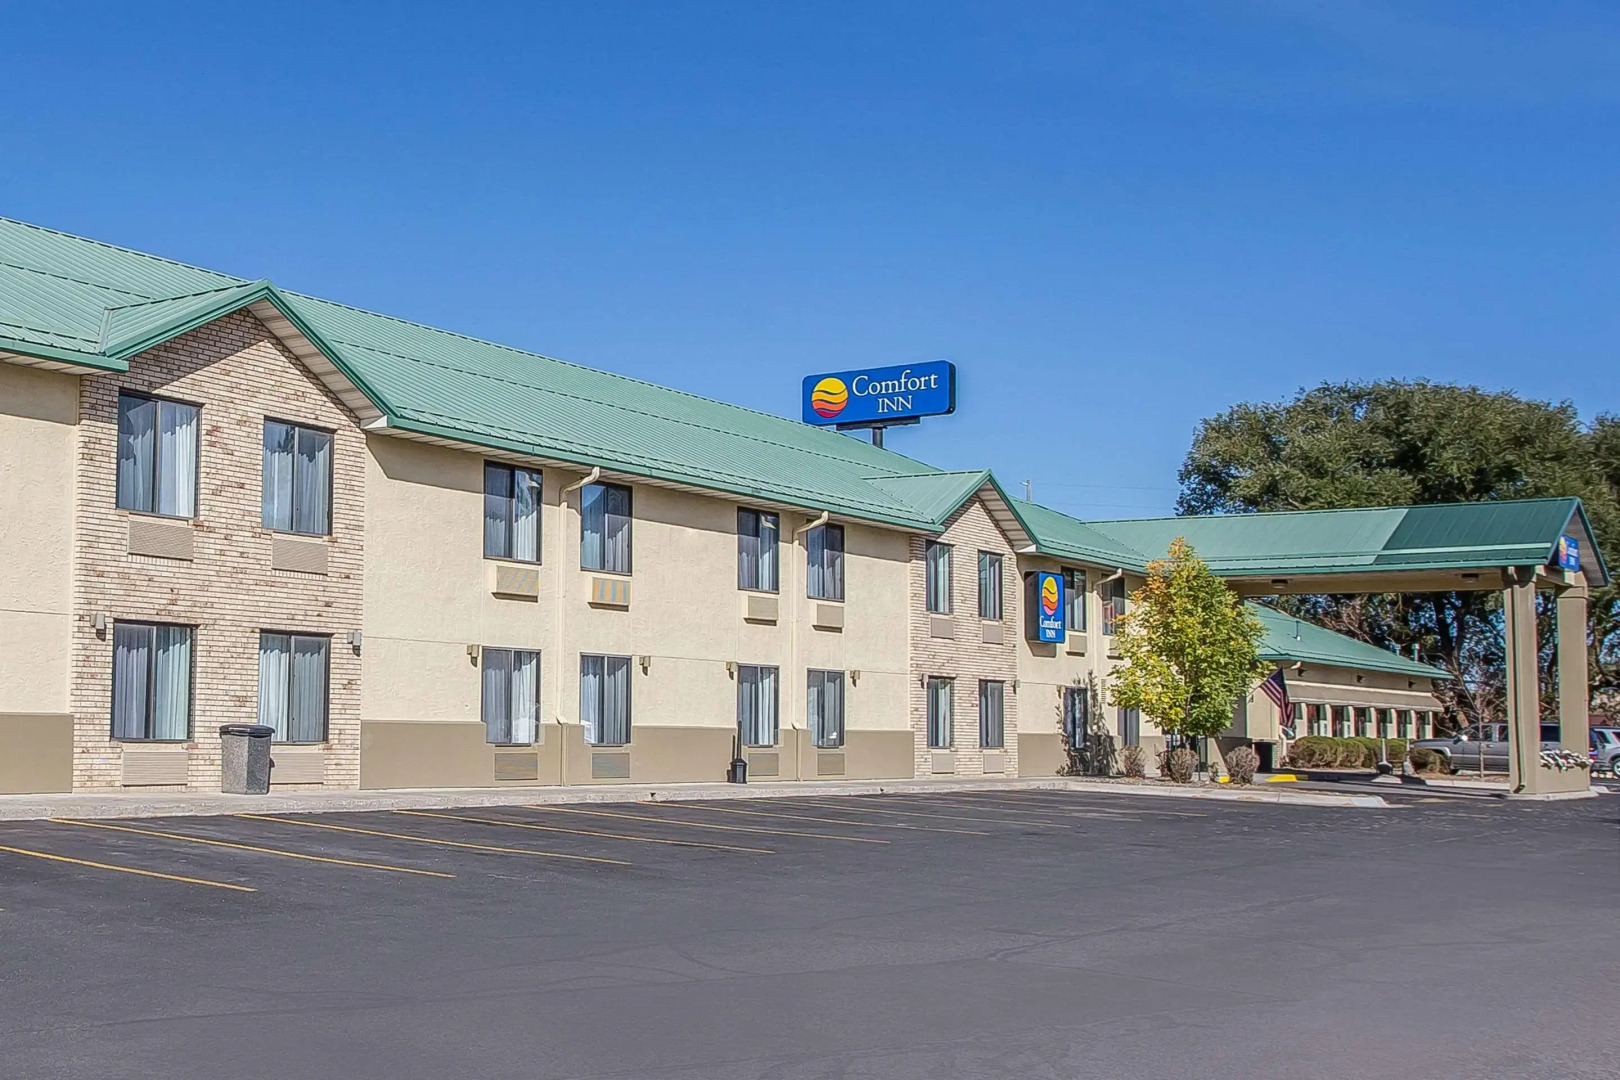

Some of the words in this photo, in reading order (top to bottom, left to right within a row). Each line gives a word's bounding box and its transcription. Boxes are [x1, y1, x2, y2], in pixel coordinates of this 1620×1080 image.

[852, 369, 938, 396] Comfort
[877, 395, 912, 413] INN
[1040, 615, 1062, 630] Comfort
